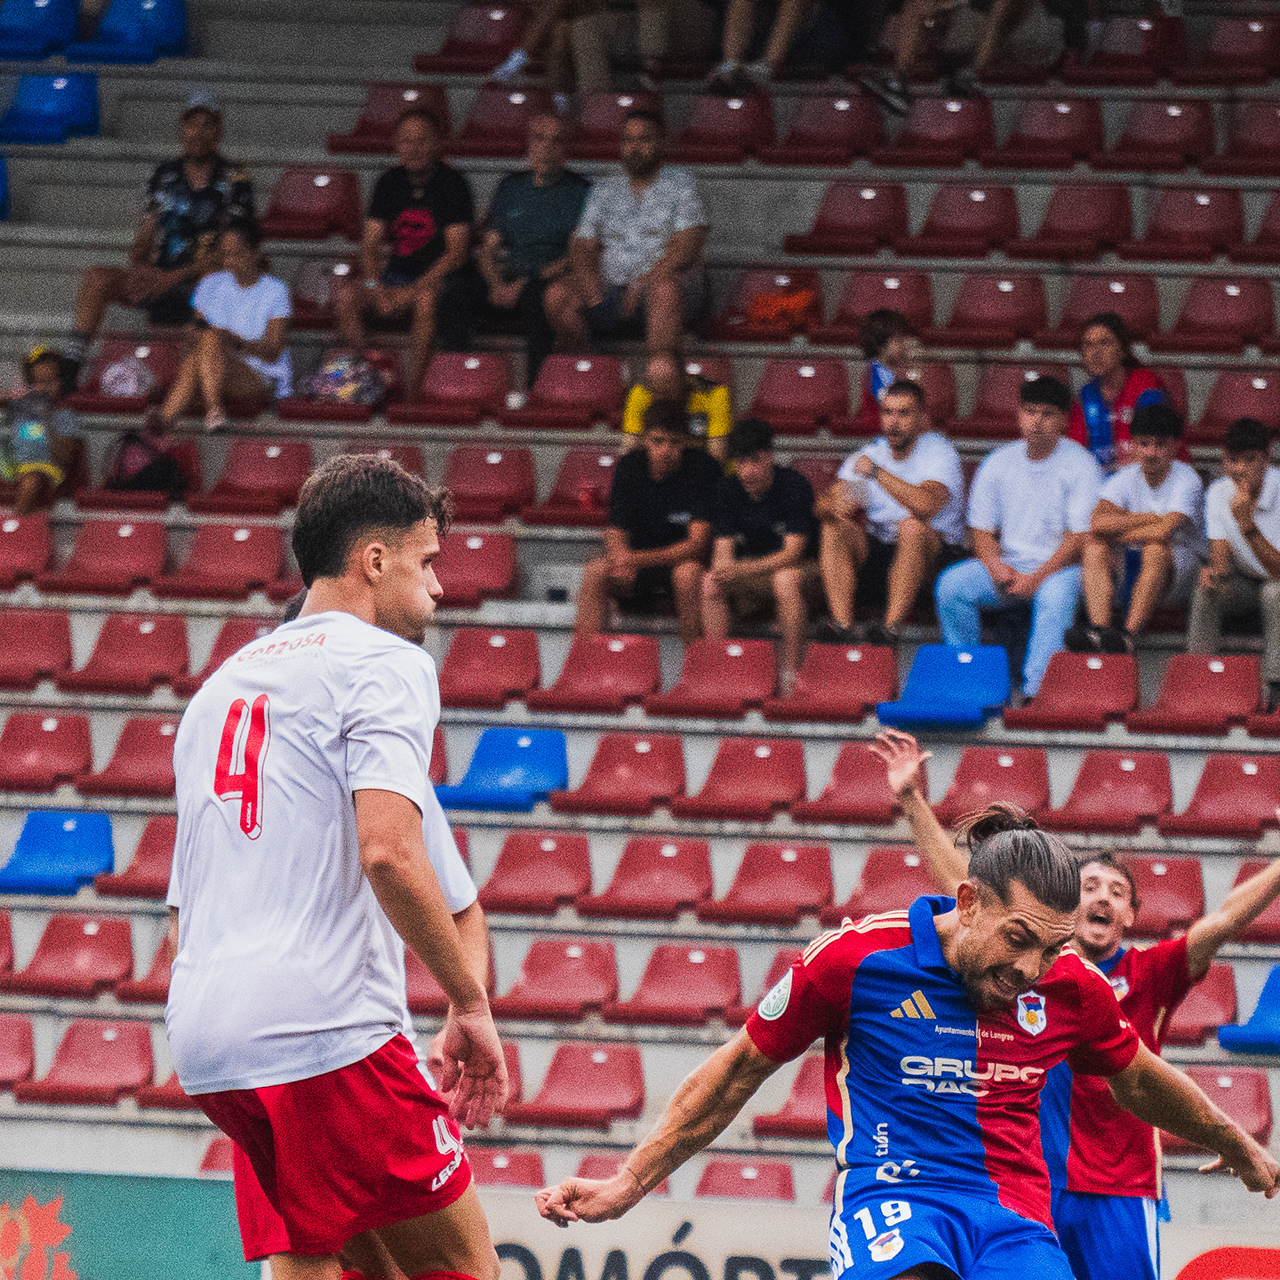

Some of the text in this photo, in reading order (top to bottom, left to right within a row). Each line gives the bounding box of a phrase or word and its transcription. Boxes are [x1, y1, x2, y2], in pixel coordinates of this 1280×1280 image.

[214, 694, 270, 840] 4
[935, 1024, 1014, 1042] Ayuntamiento de Langreo
[853, 1200, 912, 1240] 19
